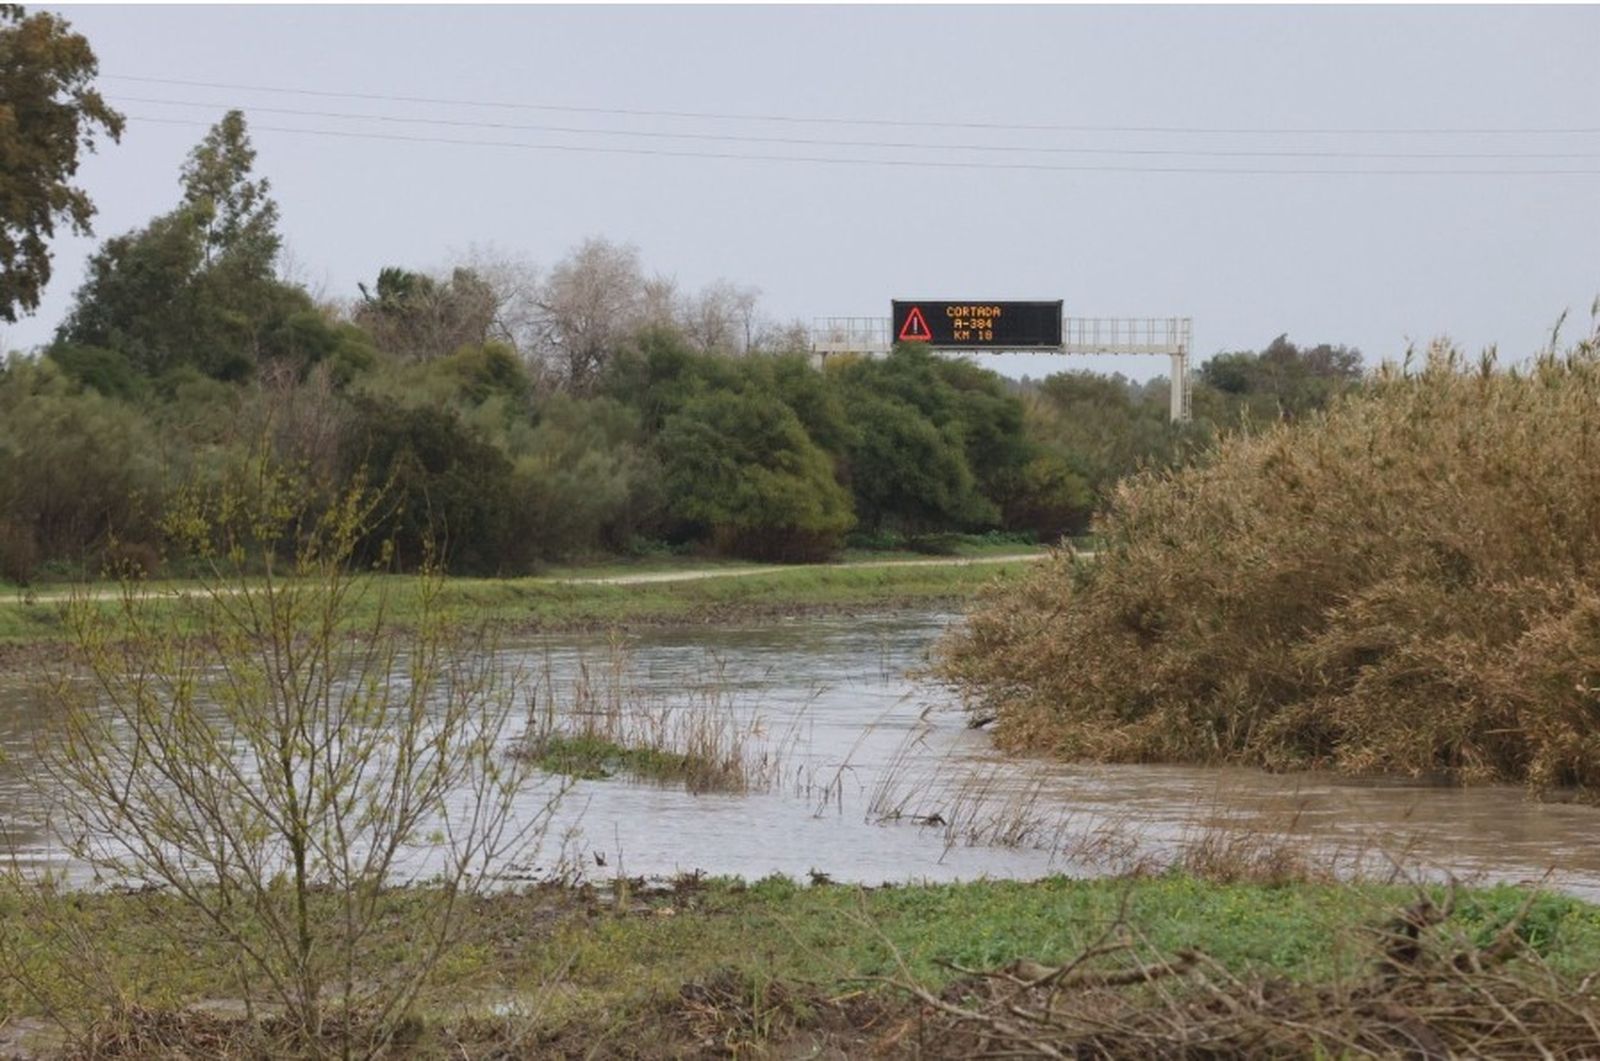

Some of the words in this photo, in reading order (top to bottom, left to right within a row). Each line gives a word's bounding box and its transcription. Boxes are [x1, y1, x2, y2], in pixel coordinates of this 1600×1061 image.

[946, 306, 1001, 317] CORTADA
[954, 319, 992, 329] A-384
[954, 330, 970, 340] KM
